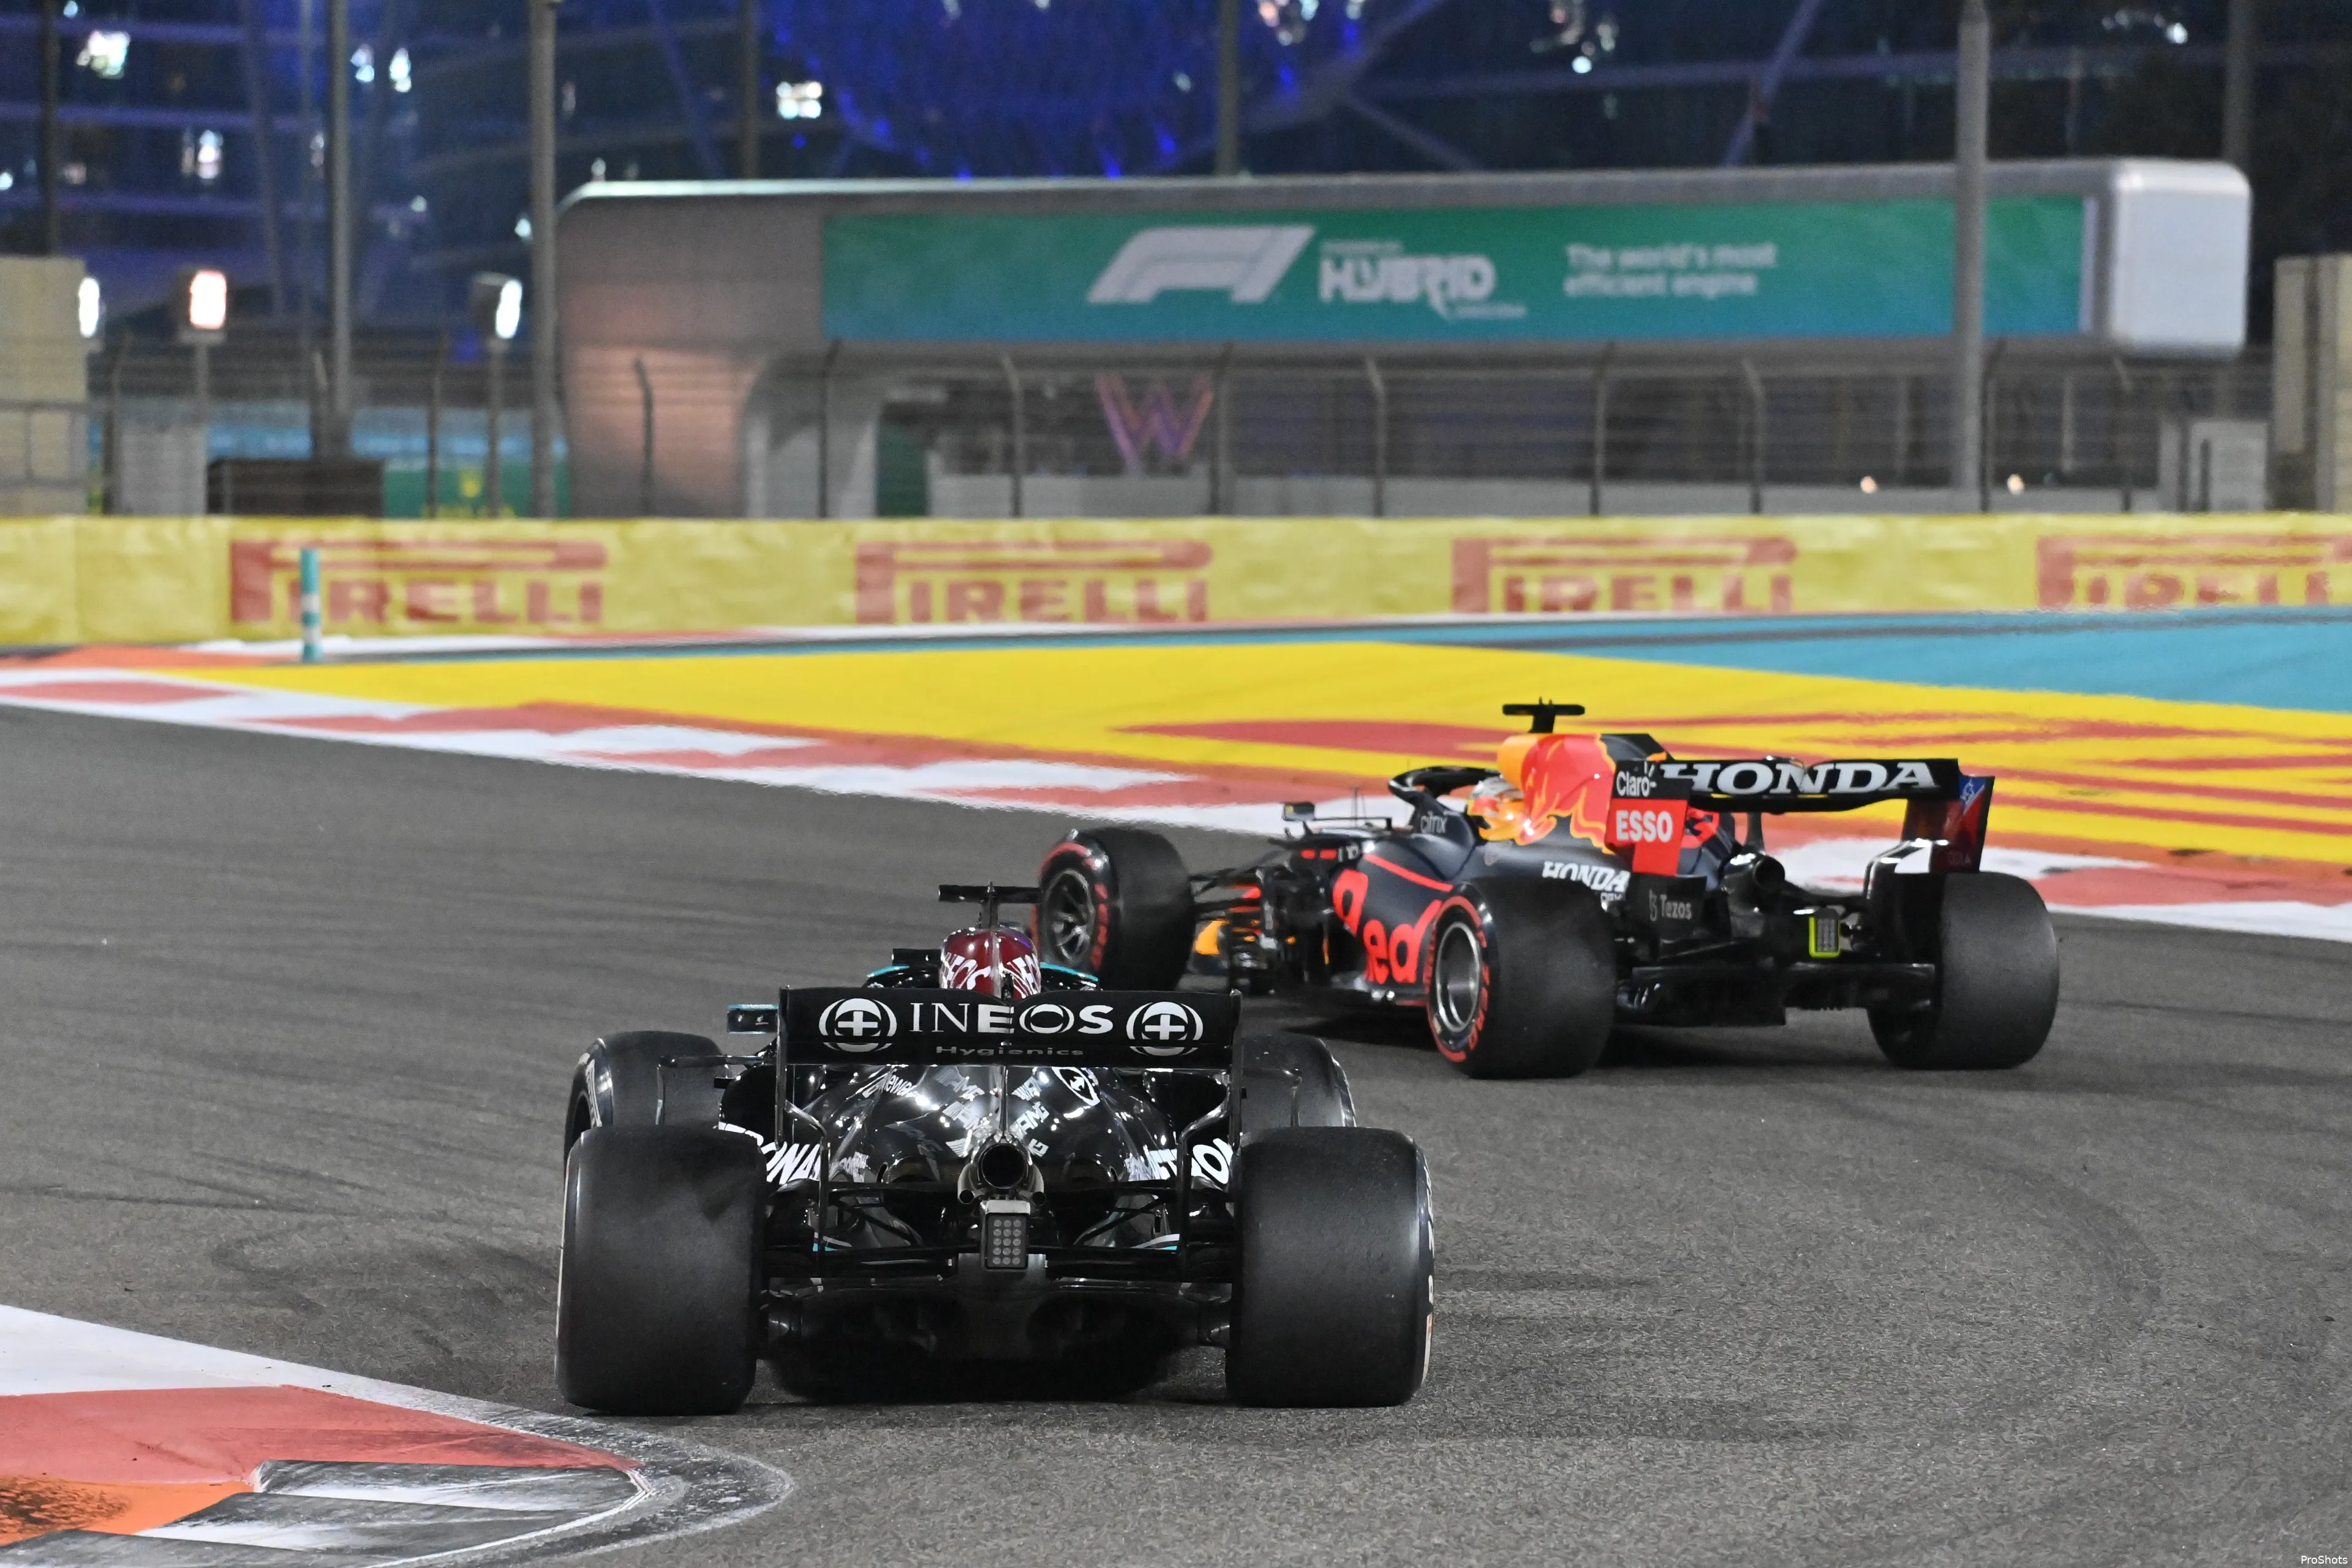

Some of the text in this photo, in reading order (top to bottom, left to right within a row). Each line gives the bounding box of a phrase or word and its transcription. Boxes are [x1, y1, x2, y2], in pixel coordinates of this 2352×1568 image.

[856, 541, 1211, 624] PIRELLI
[1451, 537, 1796, 613] PIRELLI
[1616, 771, 1650, 797] Claro
[1659, 762, 1940, 796] HONDA
[1616, 809, 1673, 843] ESSO
[1542, 861, 1630, 892] HONDA
[909, 1002, 1114, 1035] INEOS
[936, 1045, 1084, 1058] Hygienics
